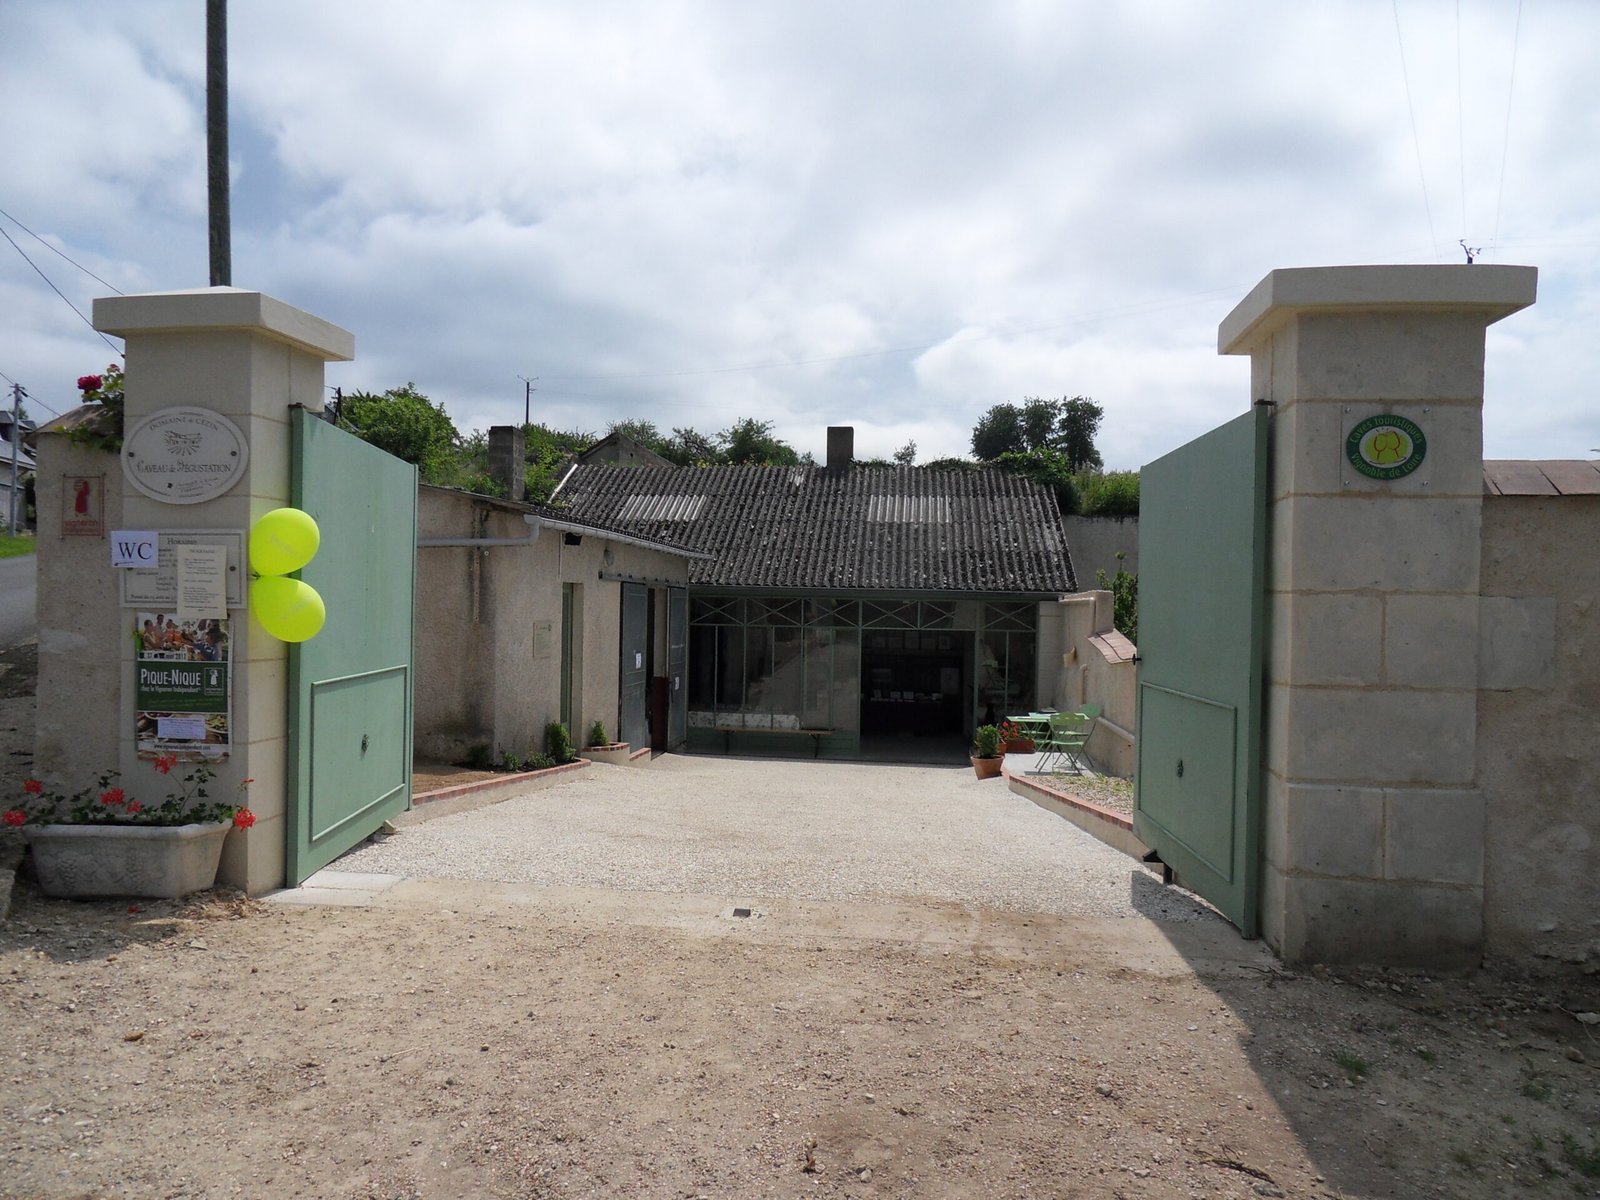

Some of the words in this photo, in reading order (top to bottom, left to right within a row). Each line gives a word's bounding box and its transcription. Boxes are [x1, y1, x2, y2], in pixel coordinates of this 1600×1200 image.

[1349, 421, 1372, 443] Caves
[1374, 415, 1423, 444] touristiques
[1351, 452, 1386, 478] Vignoble
[1389, 467, 1401, 478] de
[1401, 453, 1422, 473] Loire
[118, 541, 153, 560] WC
[140, 668, 201, 686] PIQUE-NIQUE
